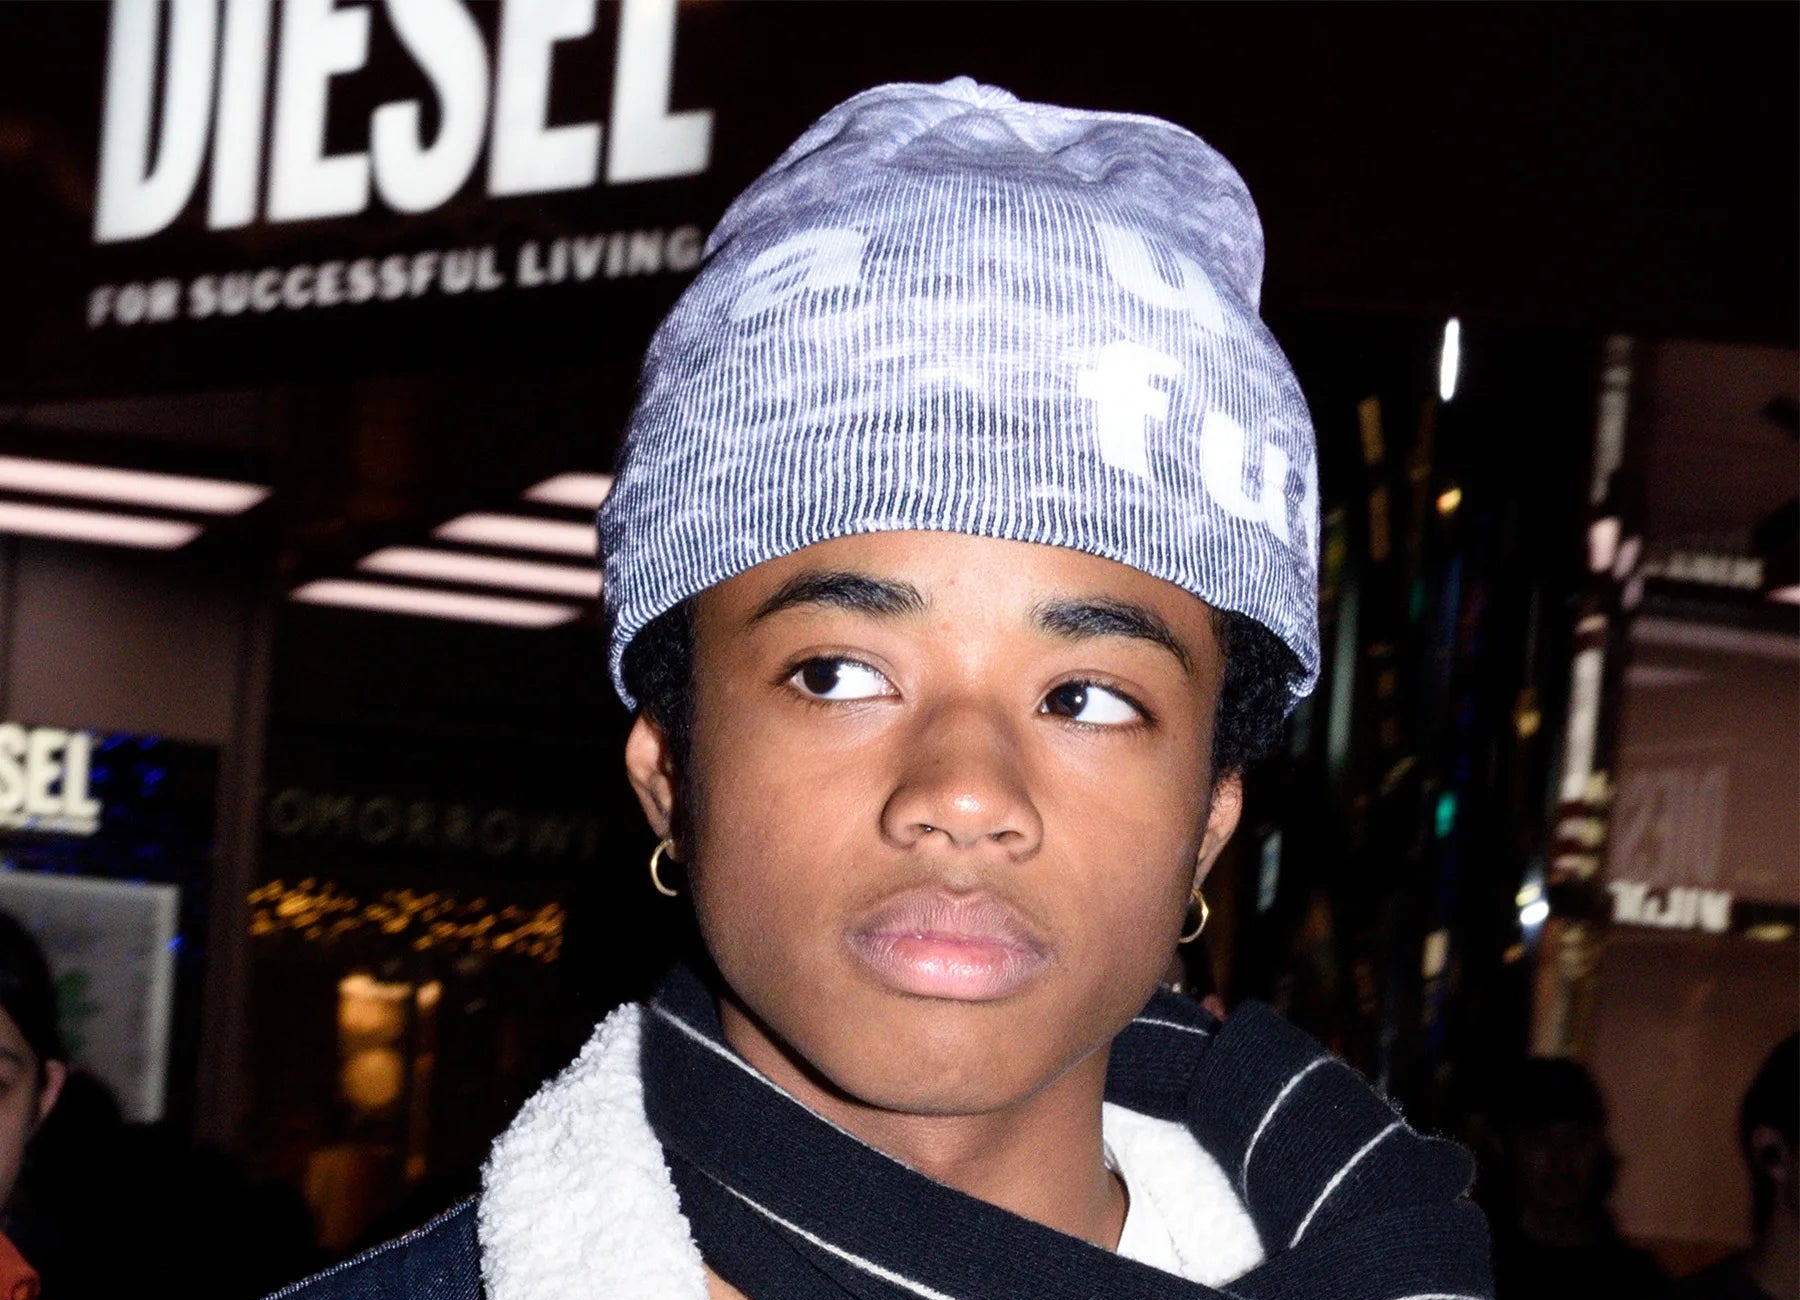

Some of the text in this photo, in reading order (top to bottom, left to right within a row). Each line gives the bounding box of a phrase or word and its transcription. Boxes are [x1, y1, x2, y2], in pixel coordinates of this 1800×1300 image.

[93, 0, 714, 243] DIESEL
[87, 223, 701, 326] FOR SUCCESSFUL LIVING
[0, 722, 101, 815] SEL
